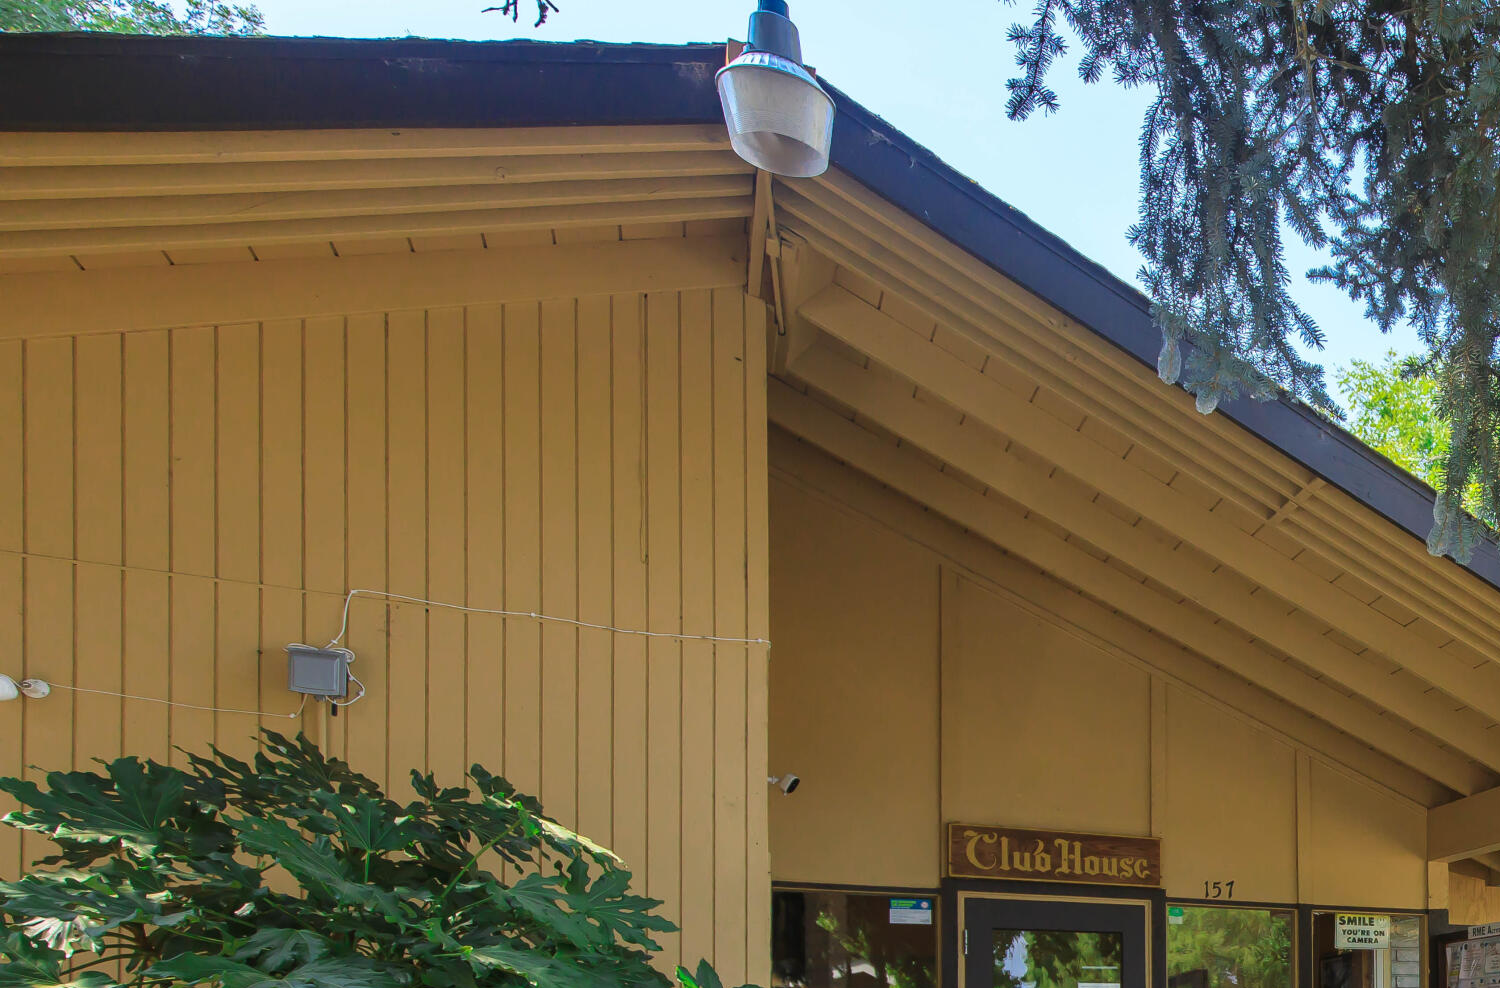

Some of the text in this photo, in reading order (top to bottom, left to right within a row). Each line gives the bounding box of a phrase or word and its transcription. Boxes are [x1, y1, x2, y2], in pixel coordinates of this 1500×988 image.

[963, 829, 1150, 879] Club House
[1204, 880, 1235, 898] 157
[1338, 915, 1375, 926] SMILE
[1341, 928, 1370, 936] YOU'RE
[1472, 926, 1486, 937] RME
[1346, 936, 1379, 944] CAMERA
